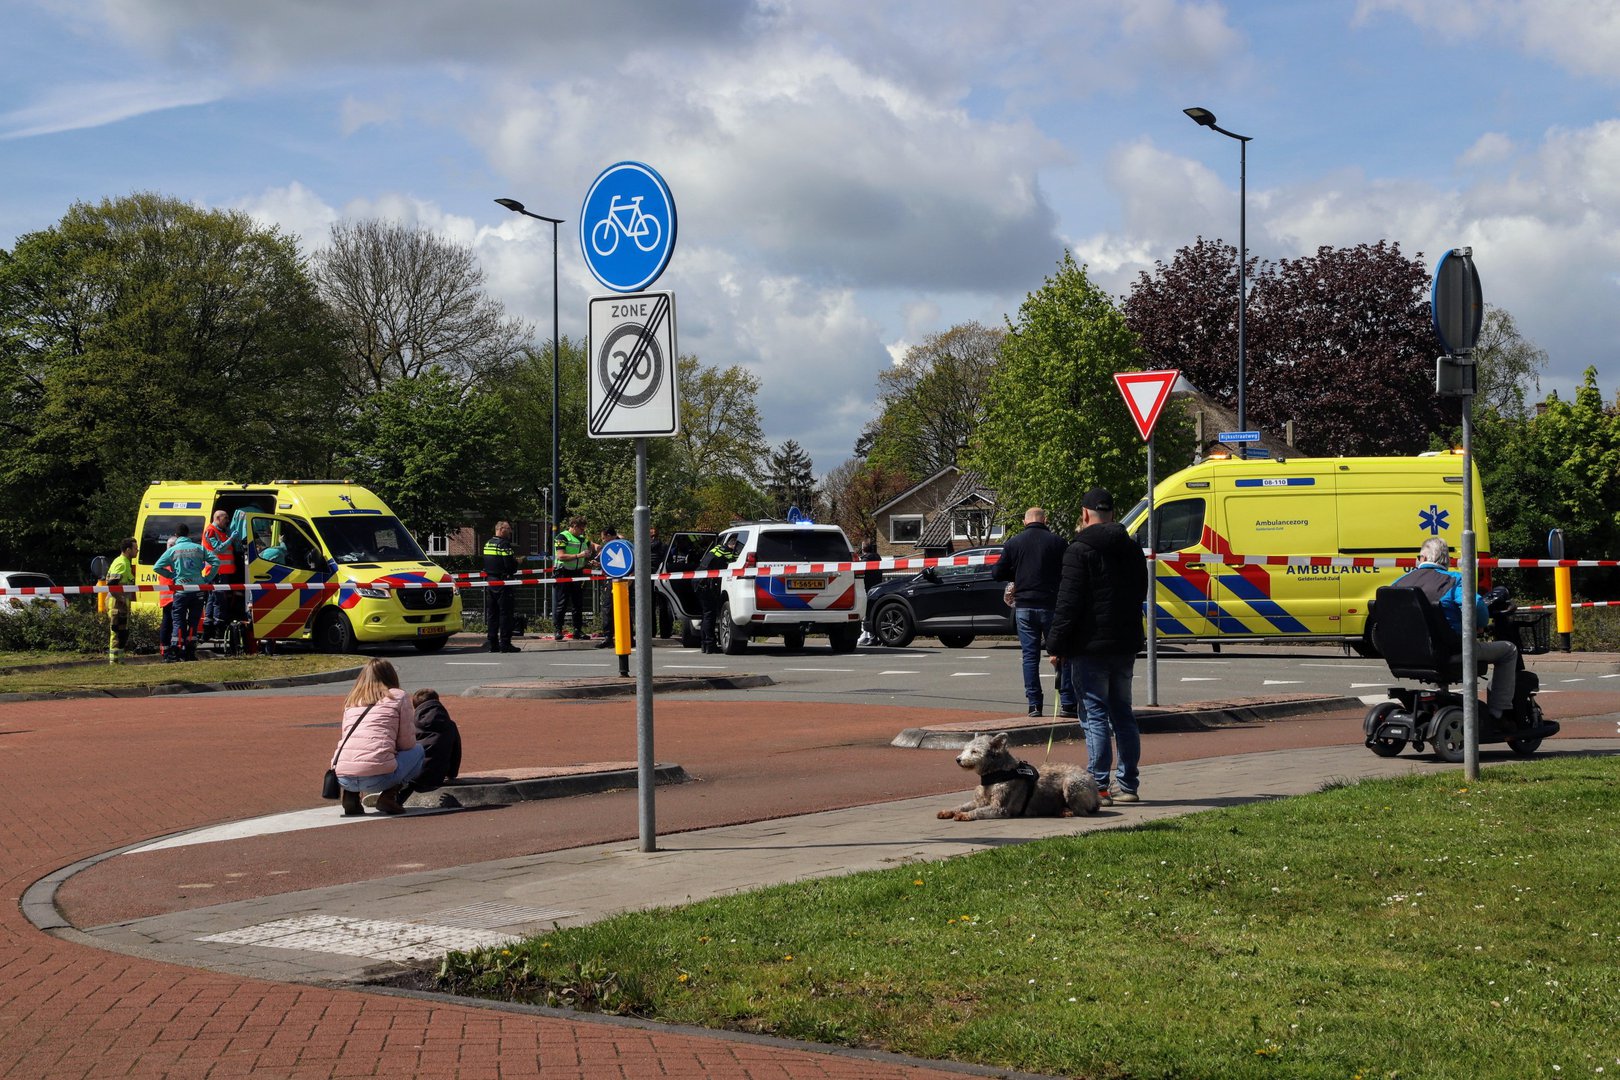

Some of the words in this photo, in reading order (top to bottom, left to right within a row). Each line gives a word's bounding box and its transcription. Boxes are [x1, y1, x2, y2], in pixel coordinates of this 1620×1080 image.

[611, 304, 648, 318] ZONE
[610, 350, 652, 381] 30
[1255, 519, 1309, 527] Ambulancezorg
[1286, 564, 1380, 575] AMBULANCE
[140, 573, 158, 582] LAN
